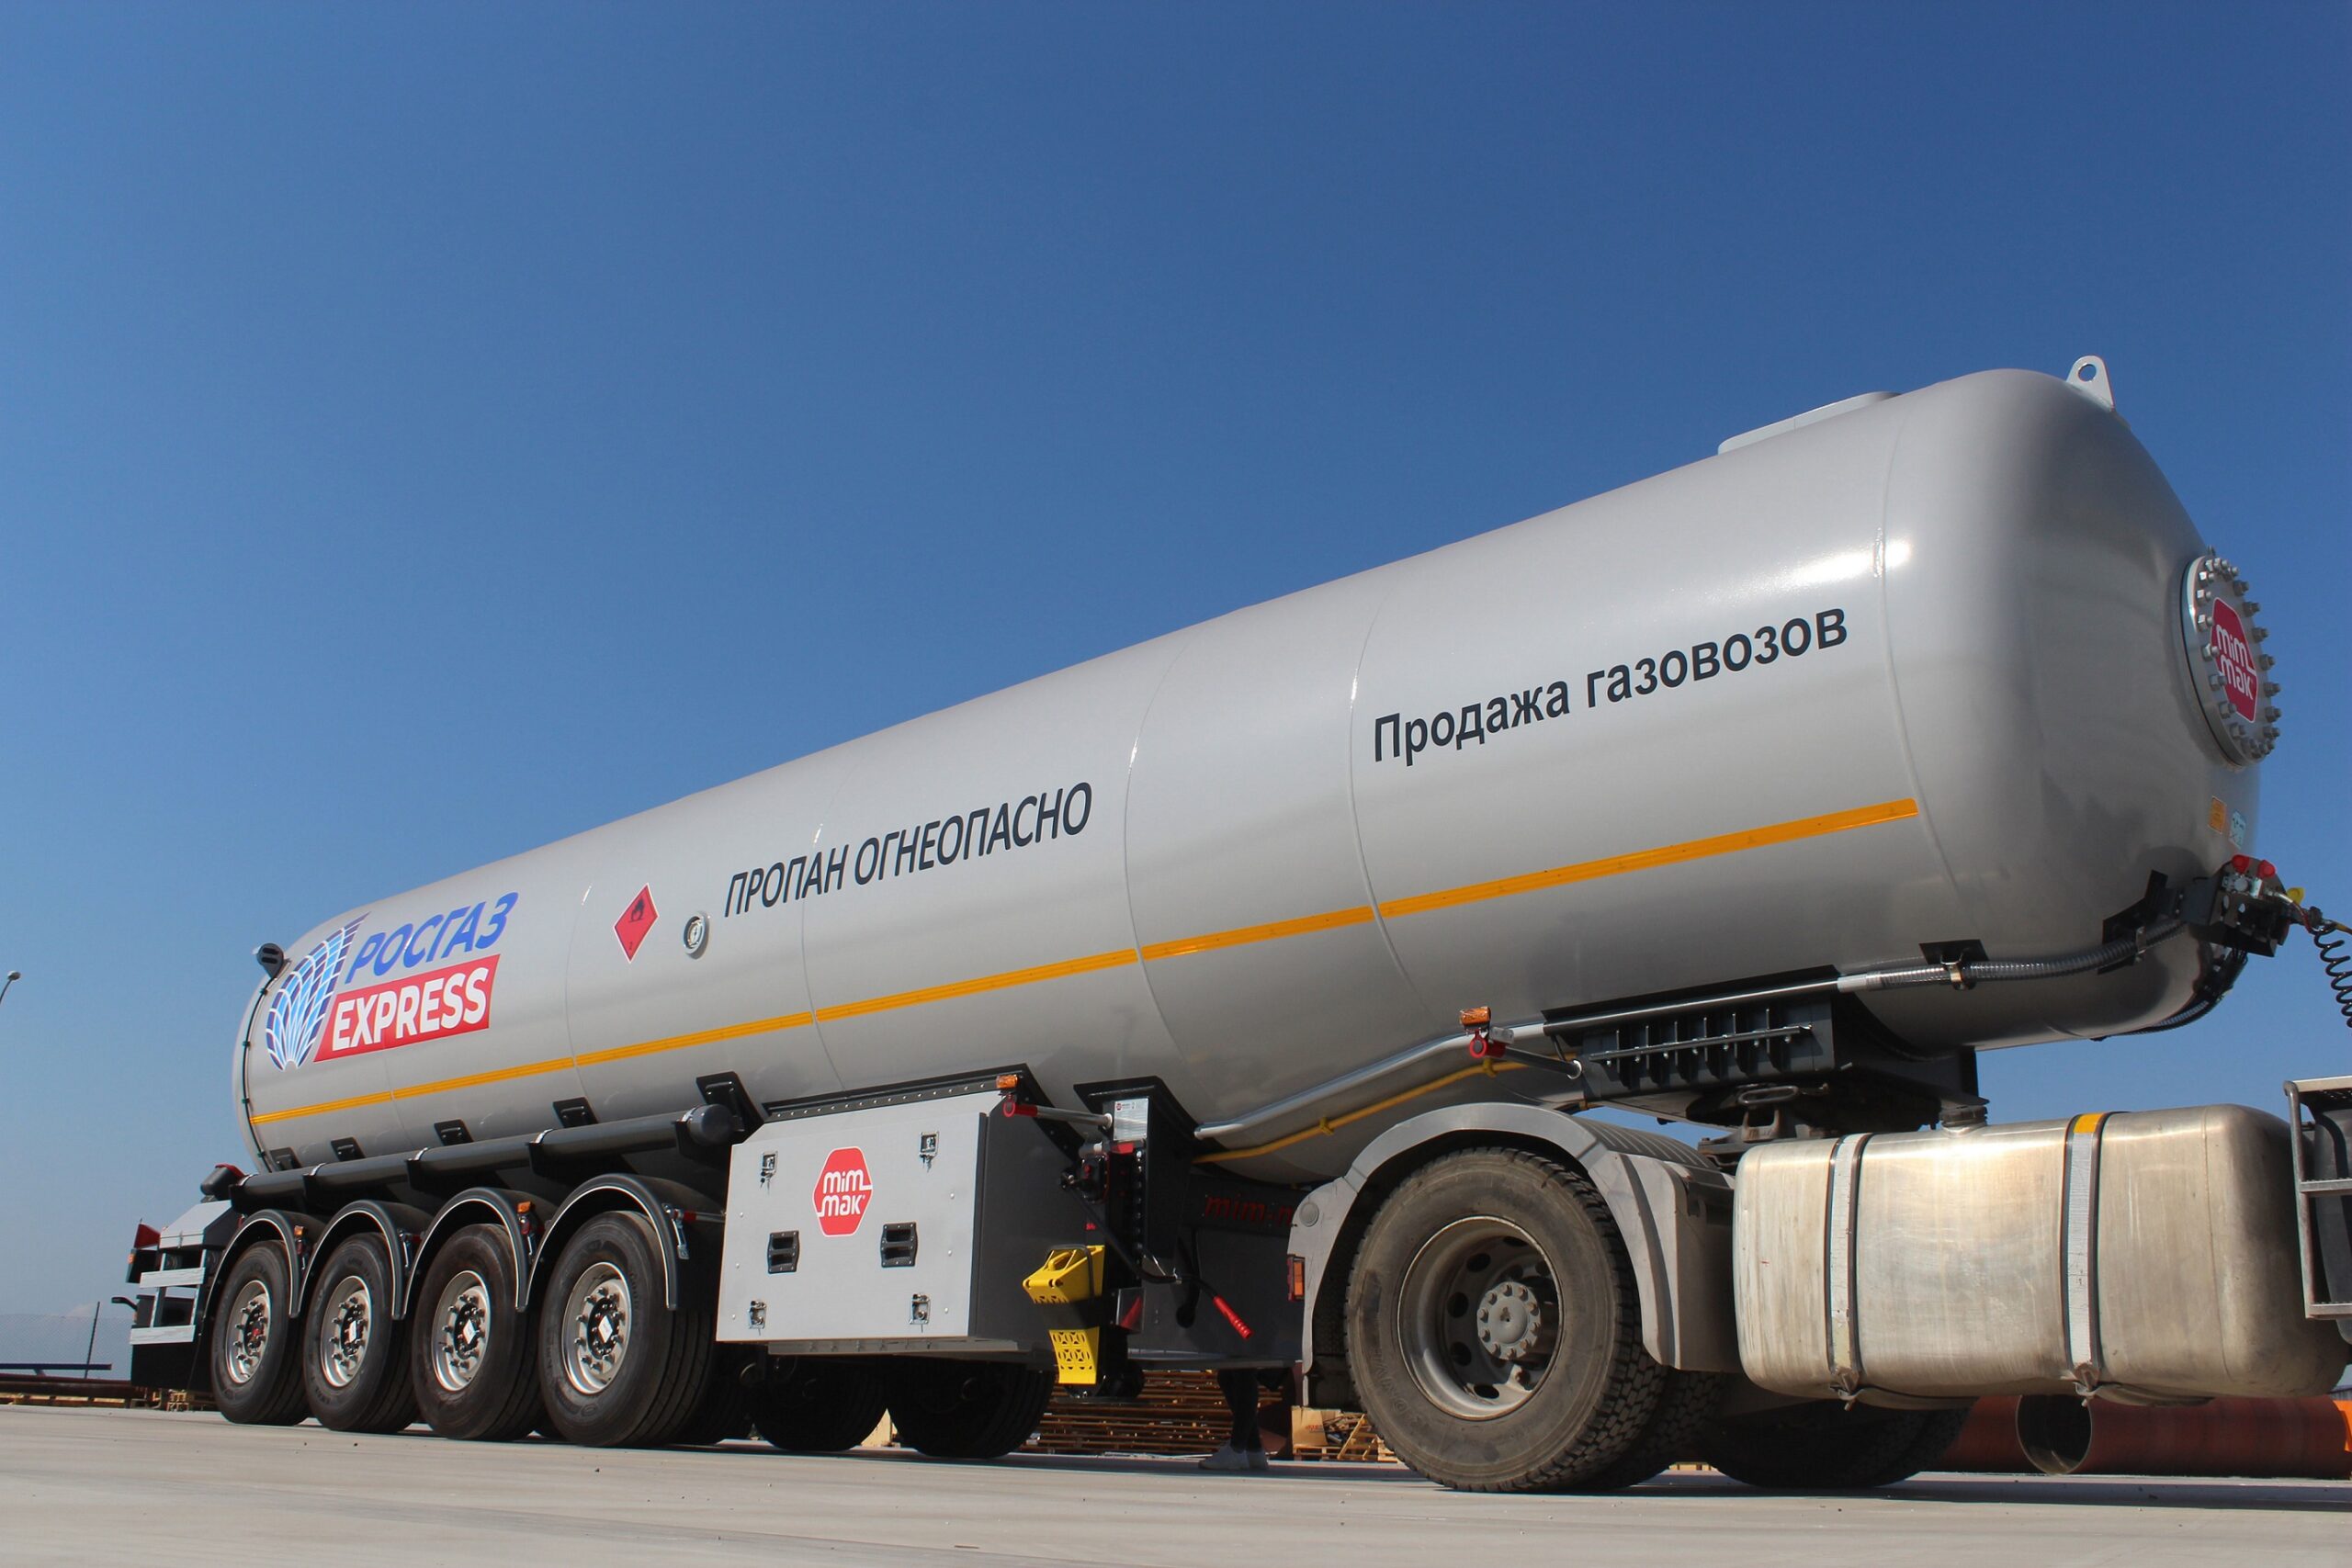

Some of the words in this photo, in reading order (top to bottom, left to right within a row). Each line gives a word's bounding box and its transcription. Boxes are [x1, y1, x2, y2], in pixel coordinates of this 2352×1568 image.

[1374, 680, 1570, 767] Продажа
[1586, 607, 1848, 709] газовозов
[724, 843, 850, 918] ПРОПАН
[854, 782, 1092, 886] ОГНЕОПАСНО
[345, 892, 519, 985] РОСГАЗ
[332, 967, 489, 1051] EXPRESS
[823, 1169, 872, 1194] mim
